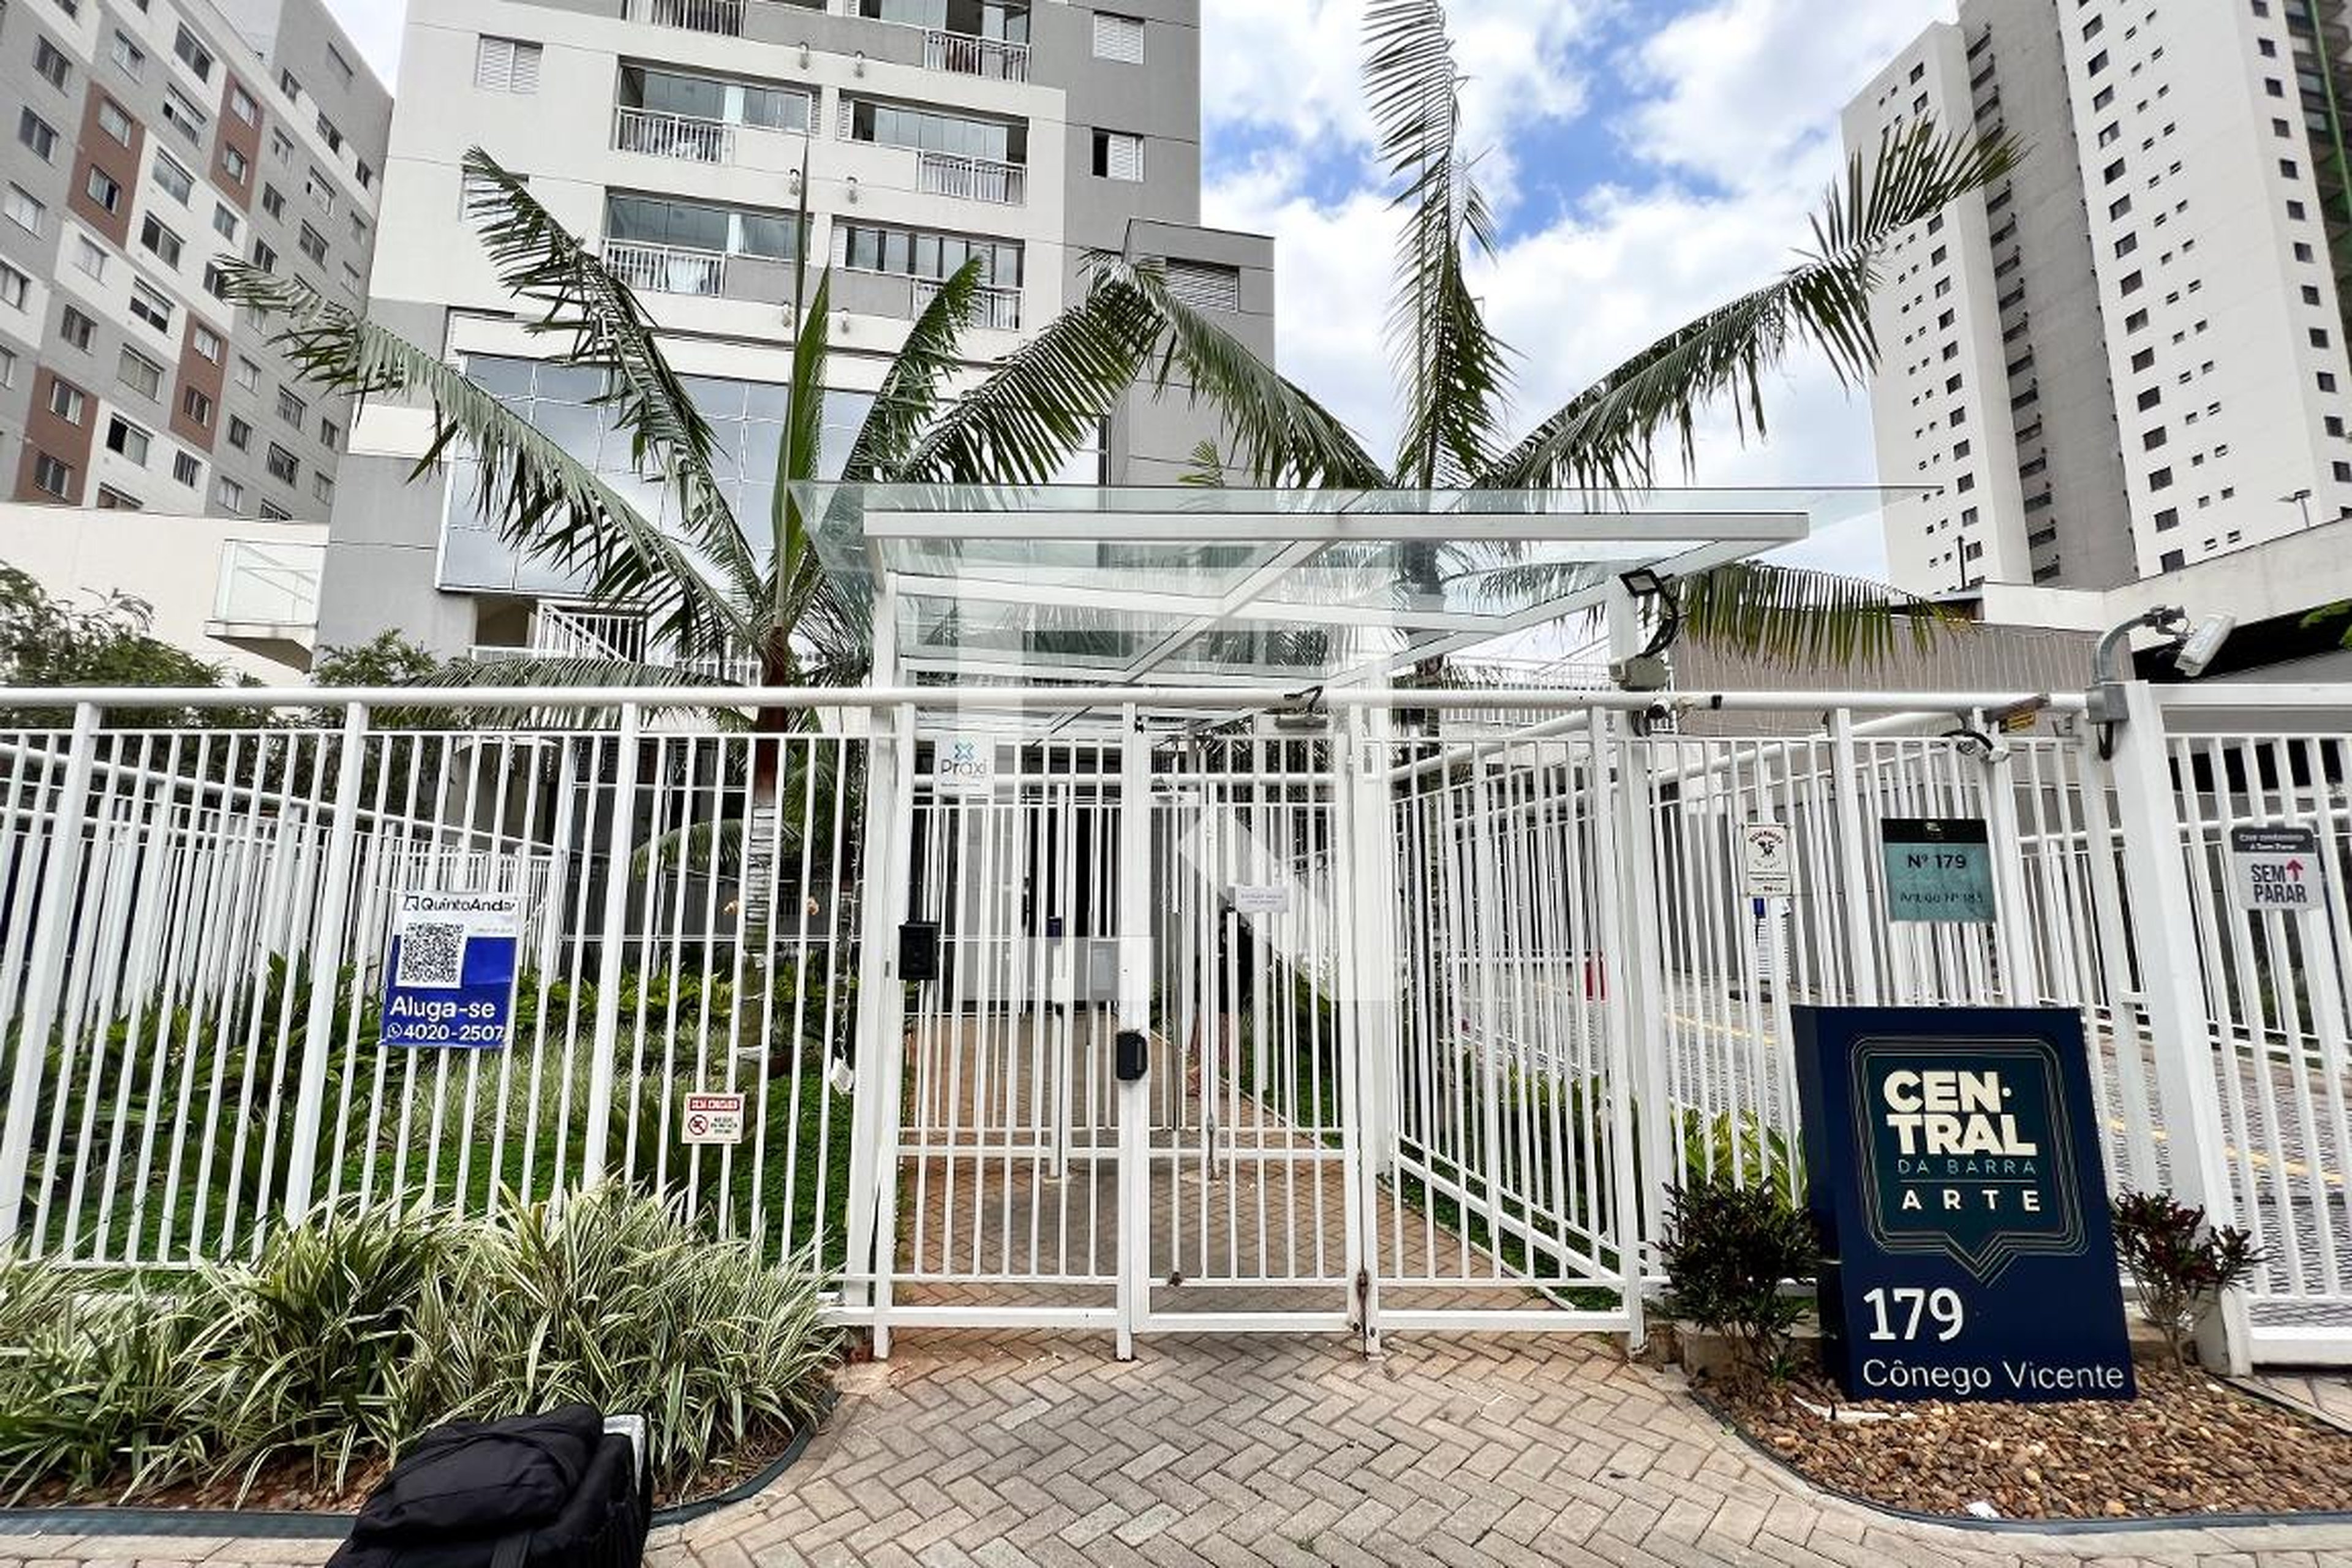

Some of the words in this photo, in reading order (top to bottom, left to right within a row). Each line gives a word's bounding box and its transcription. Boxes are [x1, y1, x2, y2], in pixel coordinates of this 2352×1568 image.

[1934, 854, 1967, 869] 179
[2251, 864, 2286, 883] SEM
[2253, 883, 2308, 903] PARAR
[420, 897, 516, 911] QuintoAndar
[389, 995, 496, 1022] Aluga-se
[404, 1024, 504, 1041] 4020-2507
[1887, 1113, 2038, 1156] TRAL
[1898, 1159, 1930, 1175] DA
[1947, 1159, 2037, 1175] BARRA
[1902, 1189, 2041, 1212] ARTE
[1863, 1287, 1964, 1342] 179
[1863, 1359, 1992, 1395] Cônego
[2002, 1361, 2125, 1389] Vicente
